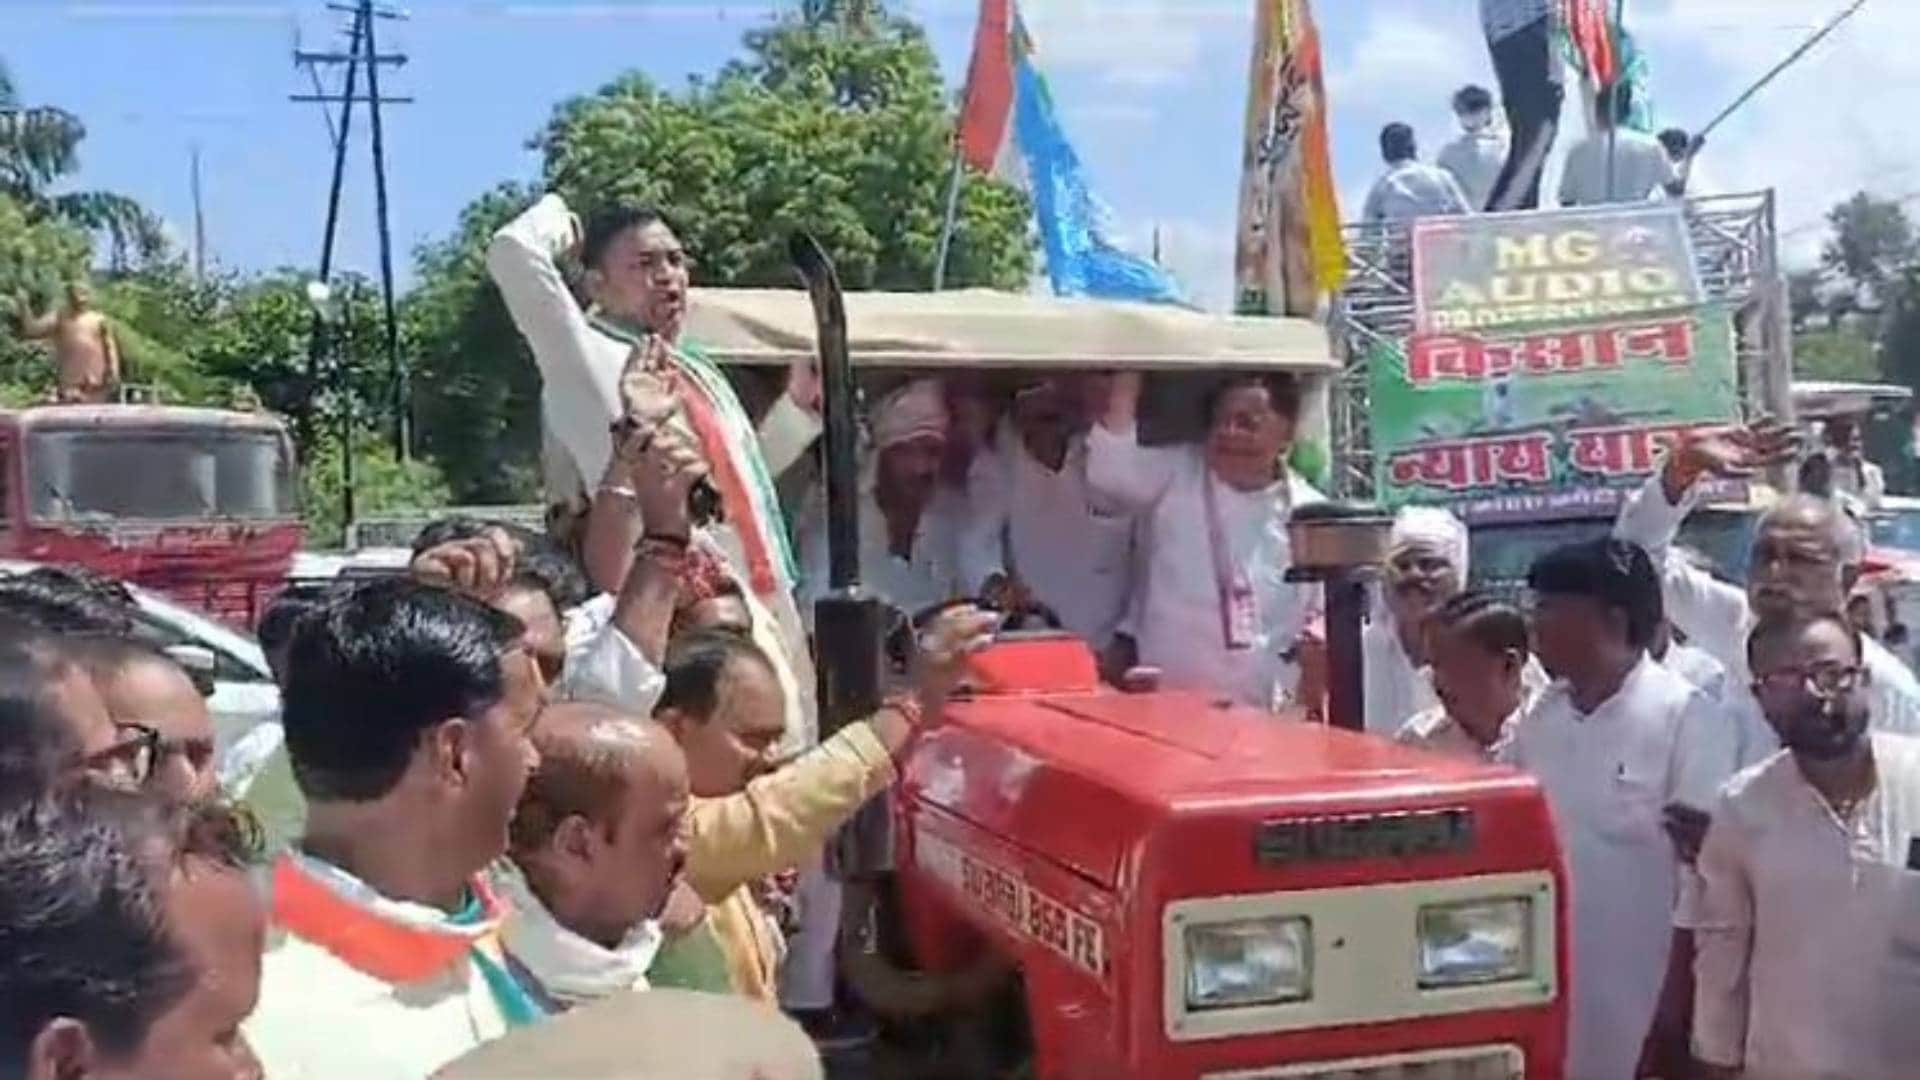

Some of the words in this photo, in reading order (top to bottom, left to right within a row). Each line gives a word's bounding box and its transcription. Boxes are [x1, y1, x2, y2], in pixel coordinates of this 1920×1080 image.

[1494, 230, 1598, 271] MG
[1433, 266, 1681, 305] AUDIO
[1407, 321, 1692, 385] किसान
[1389, 431, 1551, 490] न्याय
